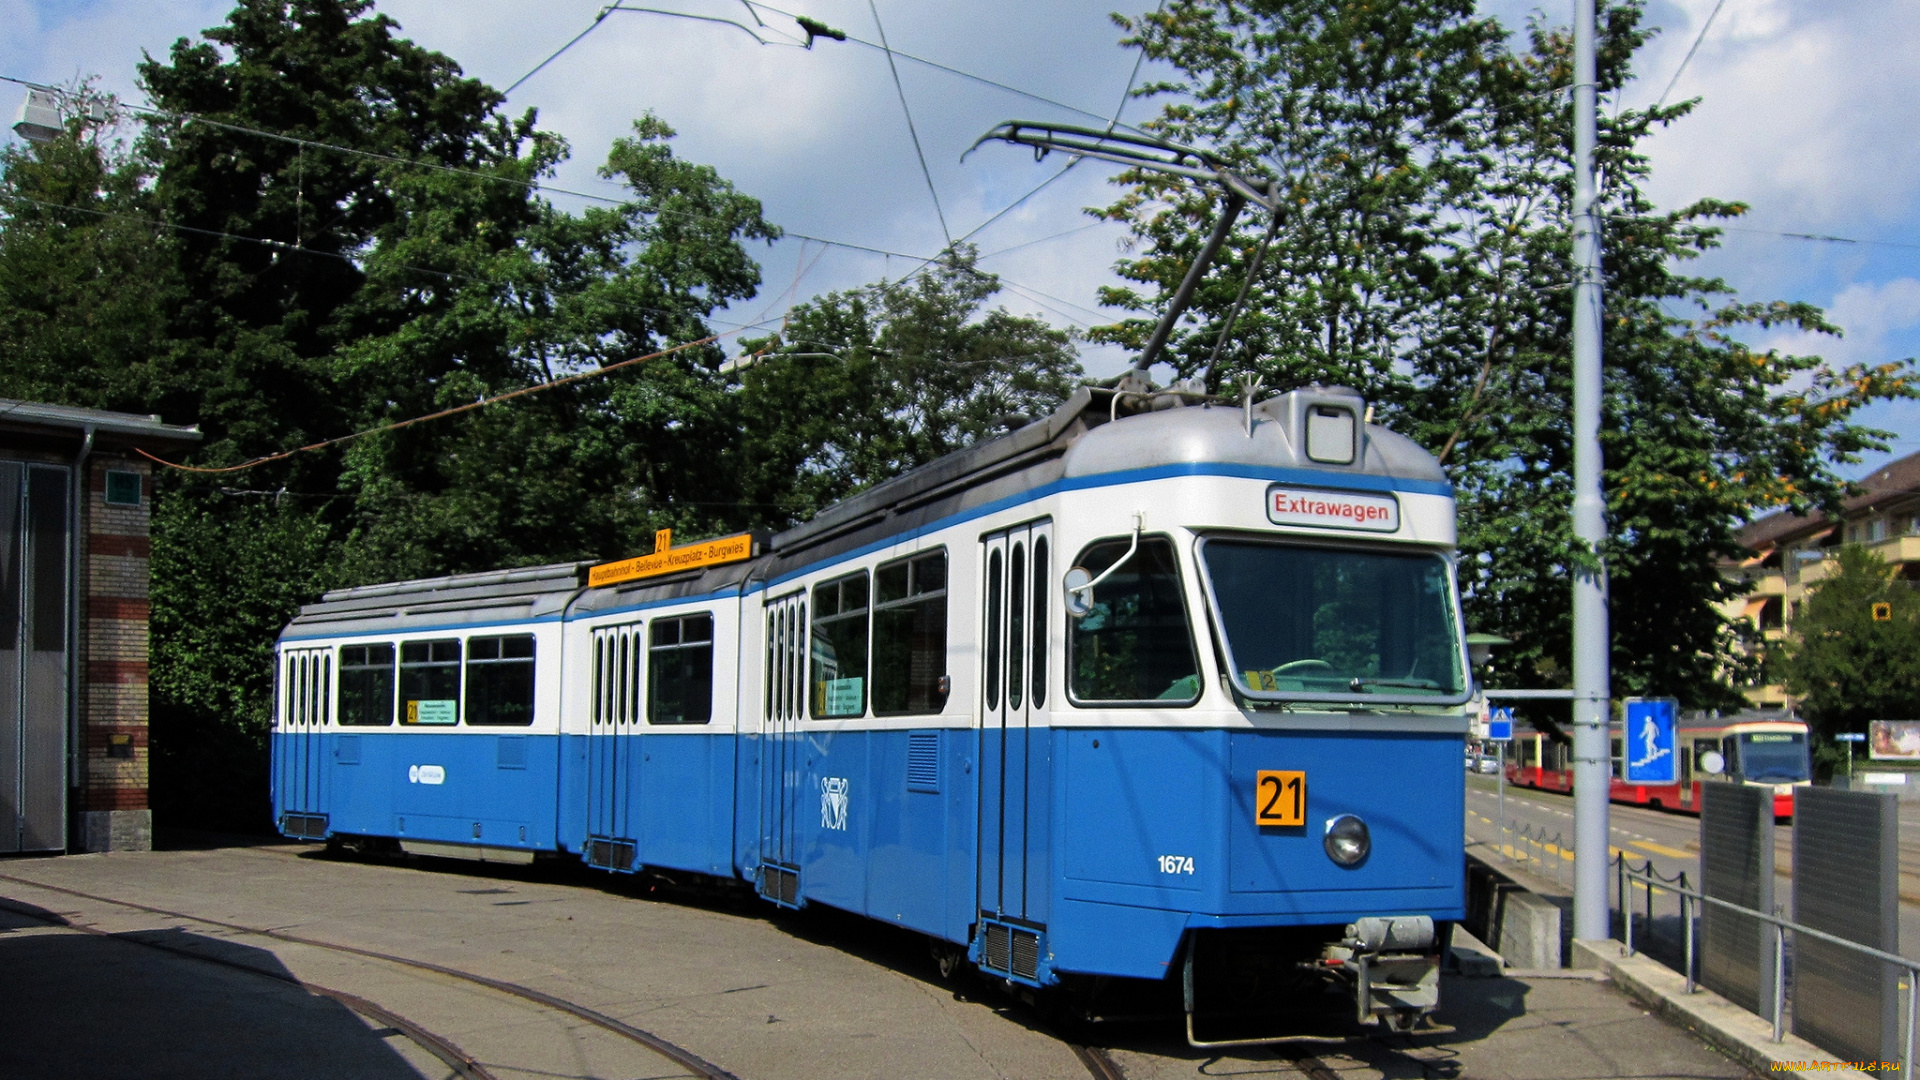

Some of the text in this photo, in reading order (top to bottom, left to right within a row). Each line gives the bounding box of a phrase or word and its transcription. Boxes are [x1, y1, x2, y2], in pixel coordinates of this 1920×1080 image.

[1275, 493, 1389, 522] Extrawagen
[656, 533, 667, 553] 21
[592, 563, 631, 581] Hauptbahnhof
[636, 559, 662, 573] Bellevue
[668, 549, 702, 566] Kreuzplatz
[709, 543, 743, 560] Burgwies
[408, 704, 417, 719] 21
[1259, 776, 1301, 819] 21
[1158, 855, 1195, 875] 1674
